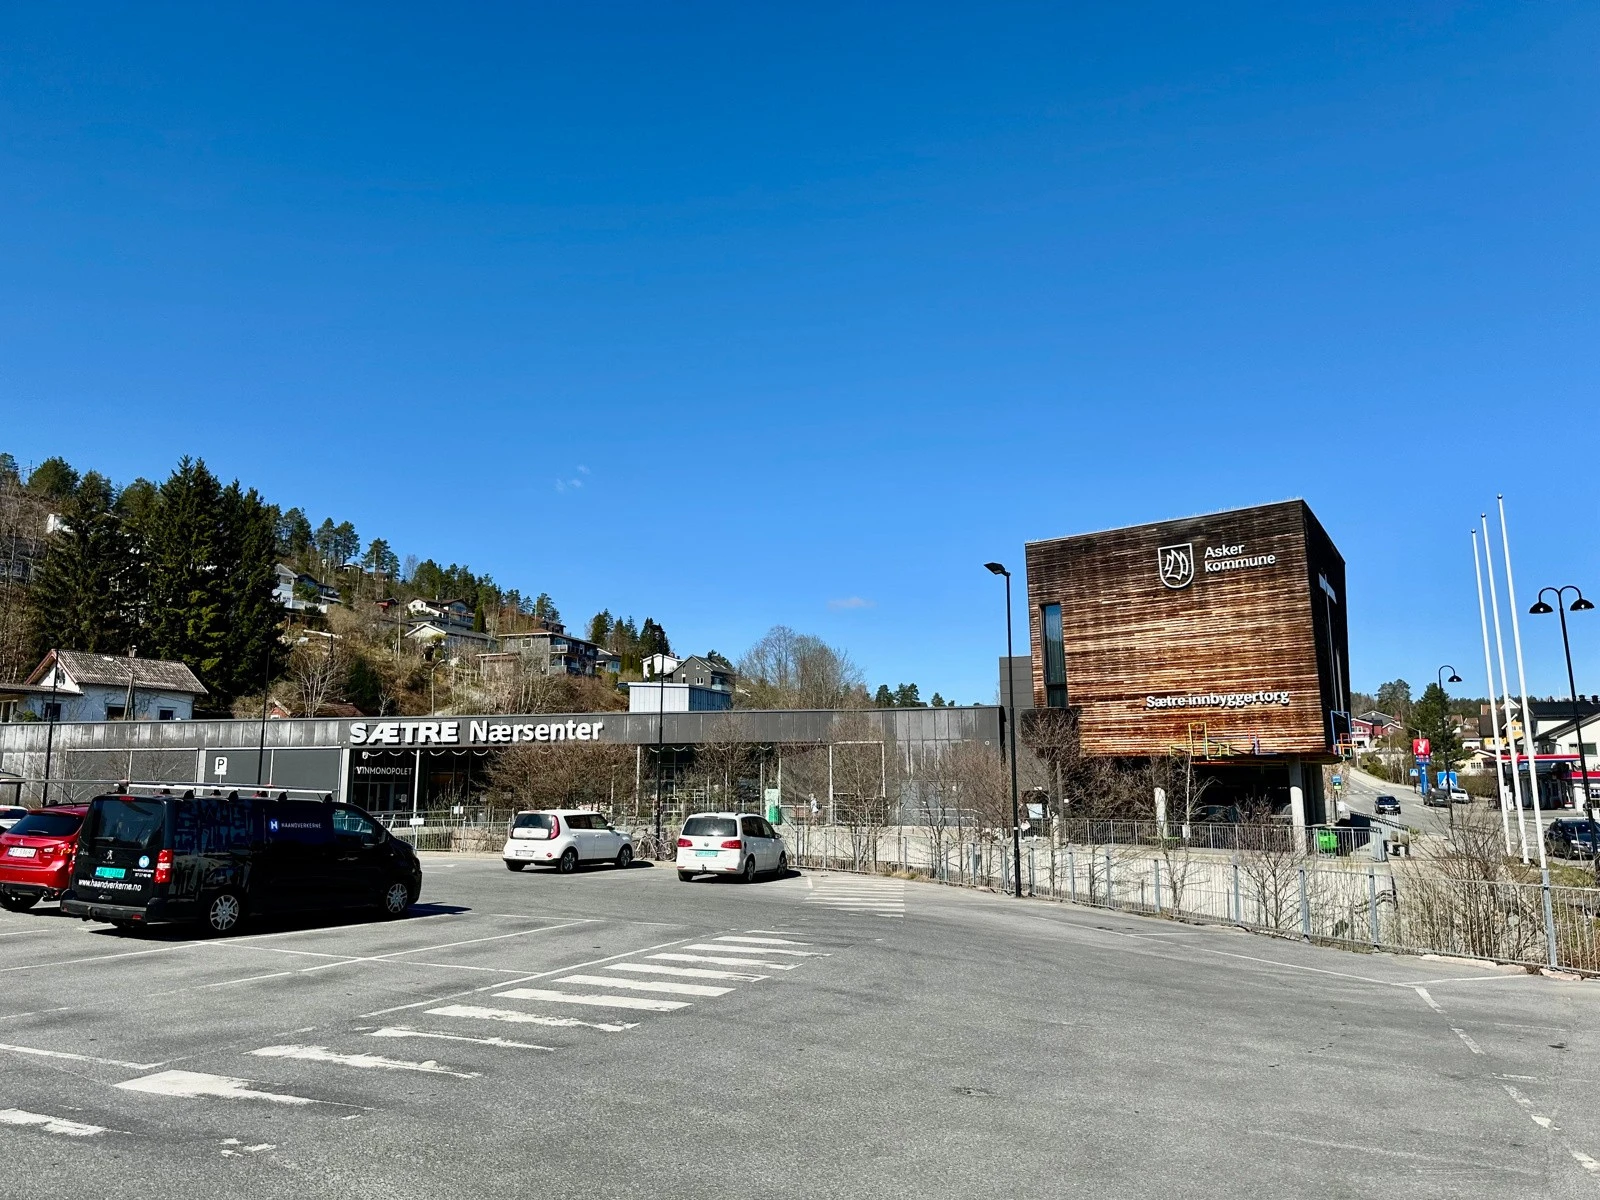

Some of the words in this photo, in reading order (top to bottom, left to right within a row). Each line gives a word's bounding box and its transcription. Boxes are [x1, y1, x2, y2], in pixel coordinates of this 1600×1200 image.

[1204, 544, 1245, 558] Asker
[1204, 554, 1276, 572] kommune
[1146, 695, 1186, 708] Sætre
[1188, 690, 1290, 707] innbyggertorg
[349, 722, 459, 744] SÆTRE
[469, 719, 604, 742] Nærsenter
[217, 758, 225, 770] P
[355, 766, 413, 776] VINMONOPOLET
[78, 879, 142, 892] www.haandverkerne.no
